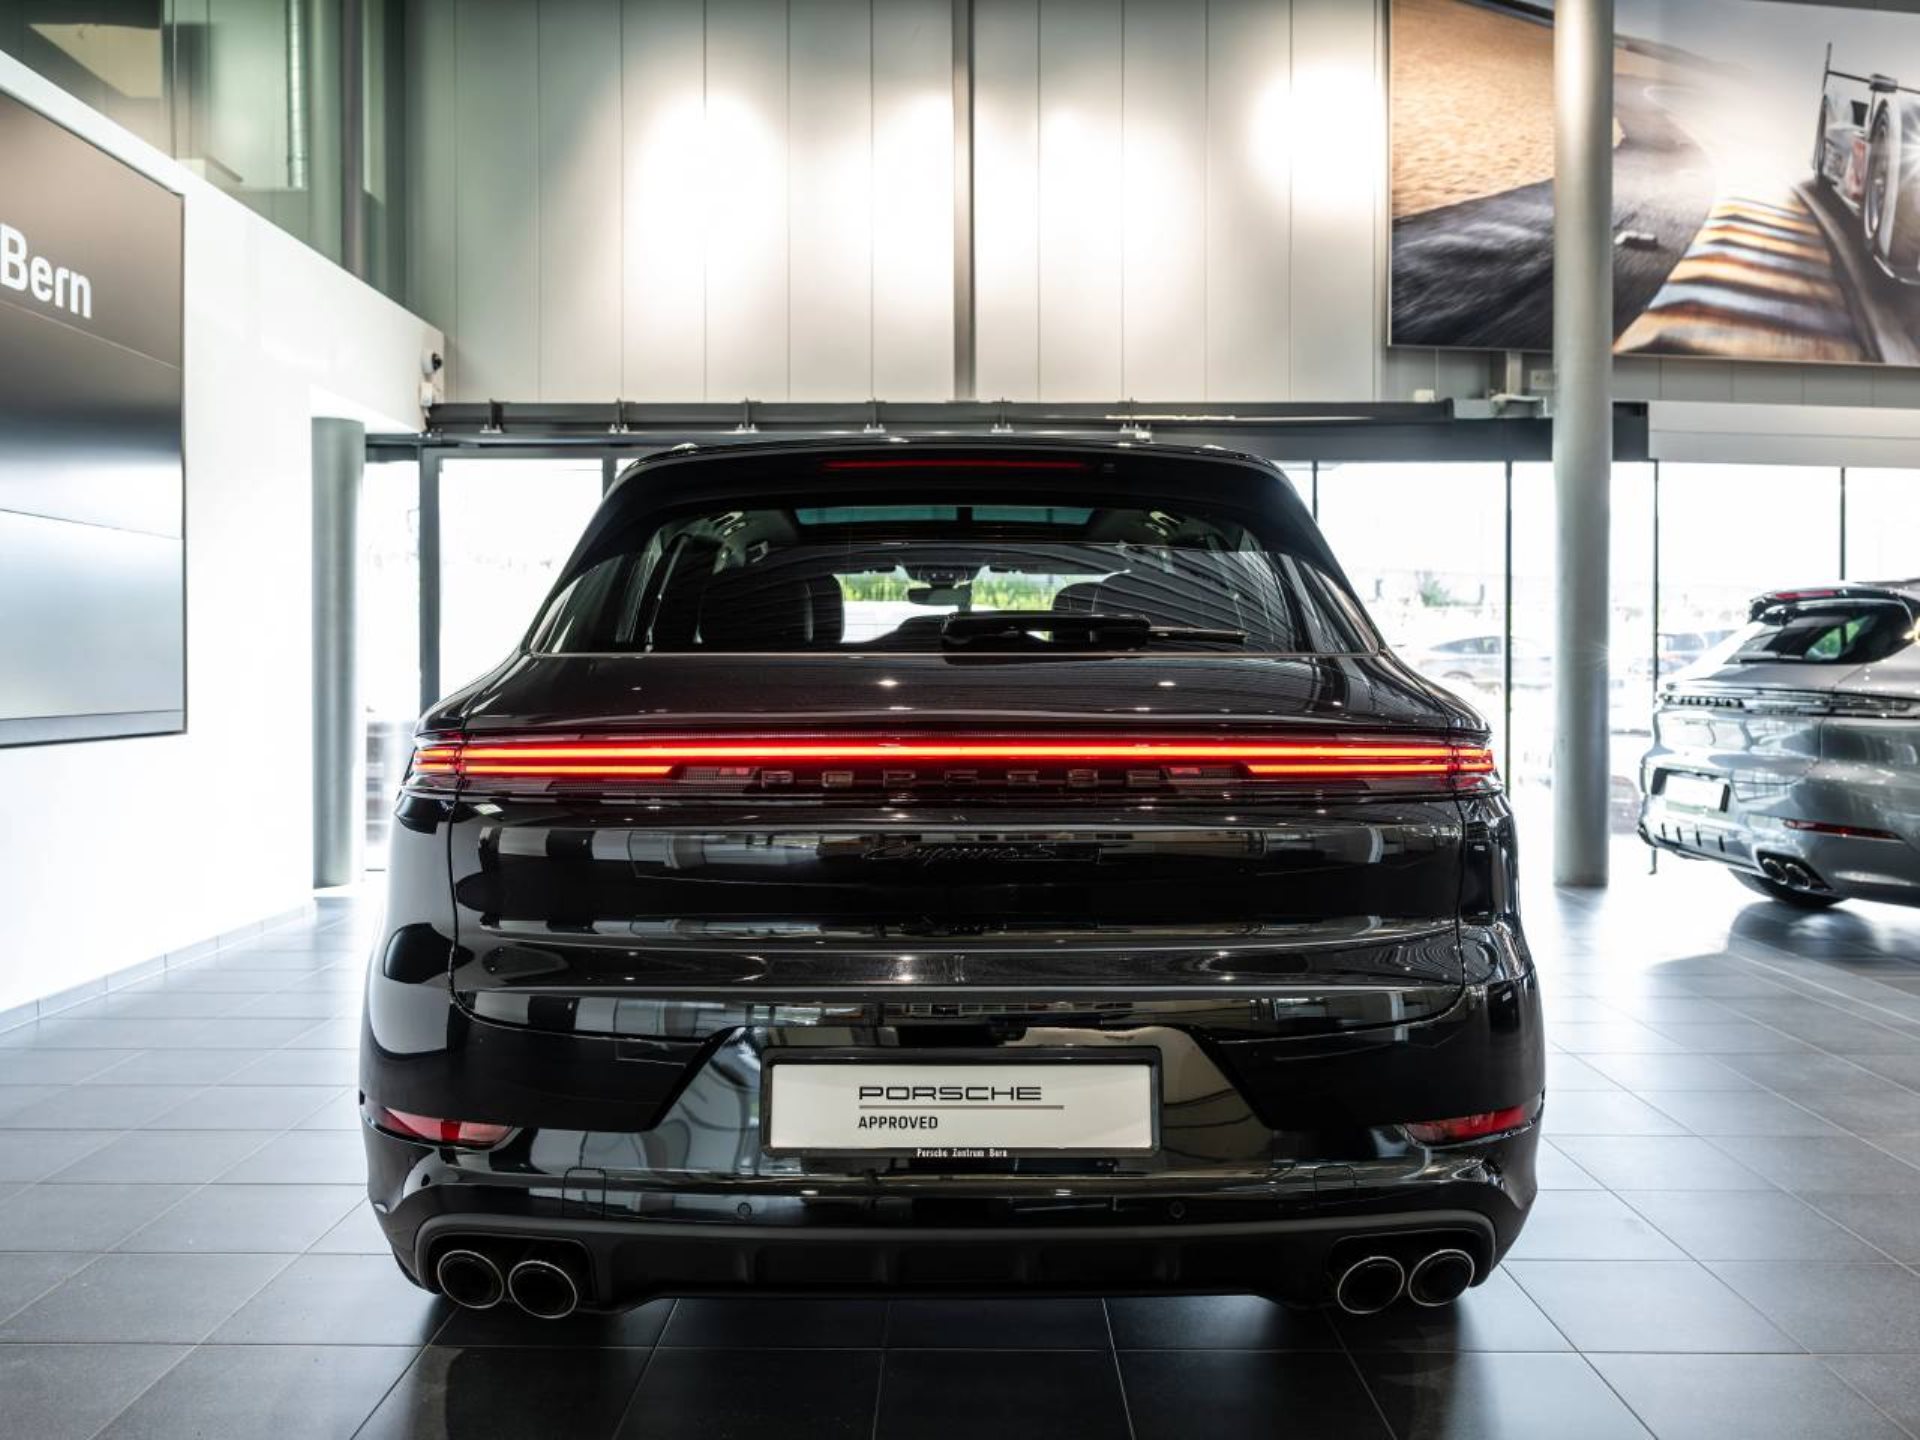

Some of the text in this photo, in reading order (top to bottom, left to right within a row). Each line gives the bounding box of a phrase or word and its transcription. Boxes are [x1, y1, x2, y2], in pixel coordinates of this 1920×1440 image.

[0, 222, 92, 319] Bern
[858, 1086, 1042, 1101] PORSCHE
[858, 1115, 939, 1130] APPROVED
